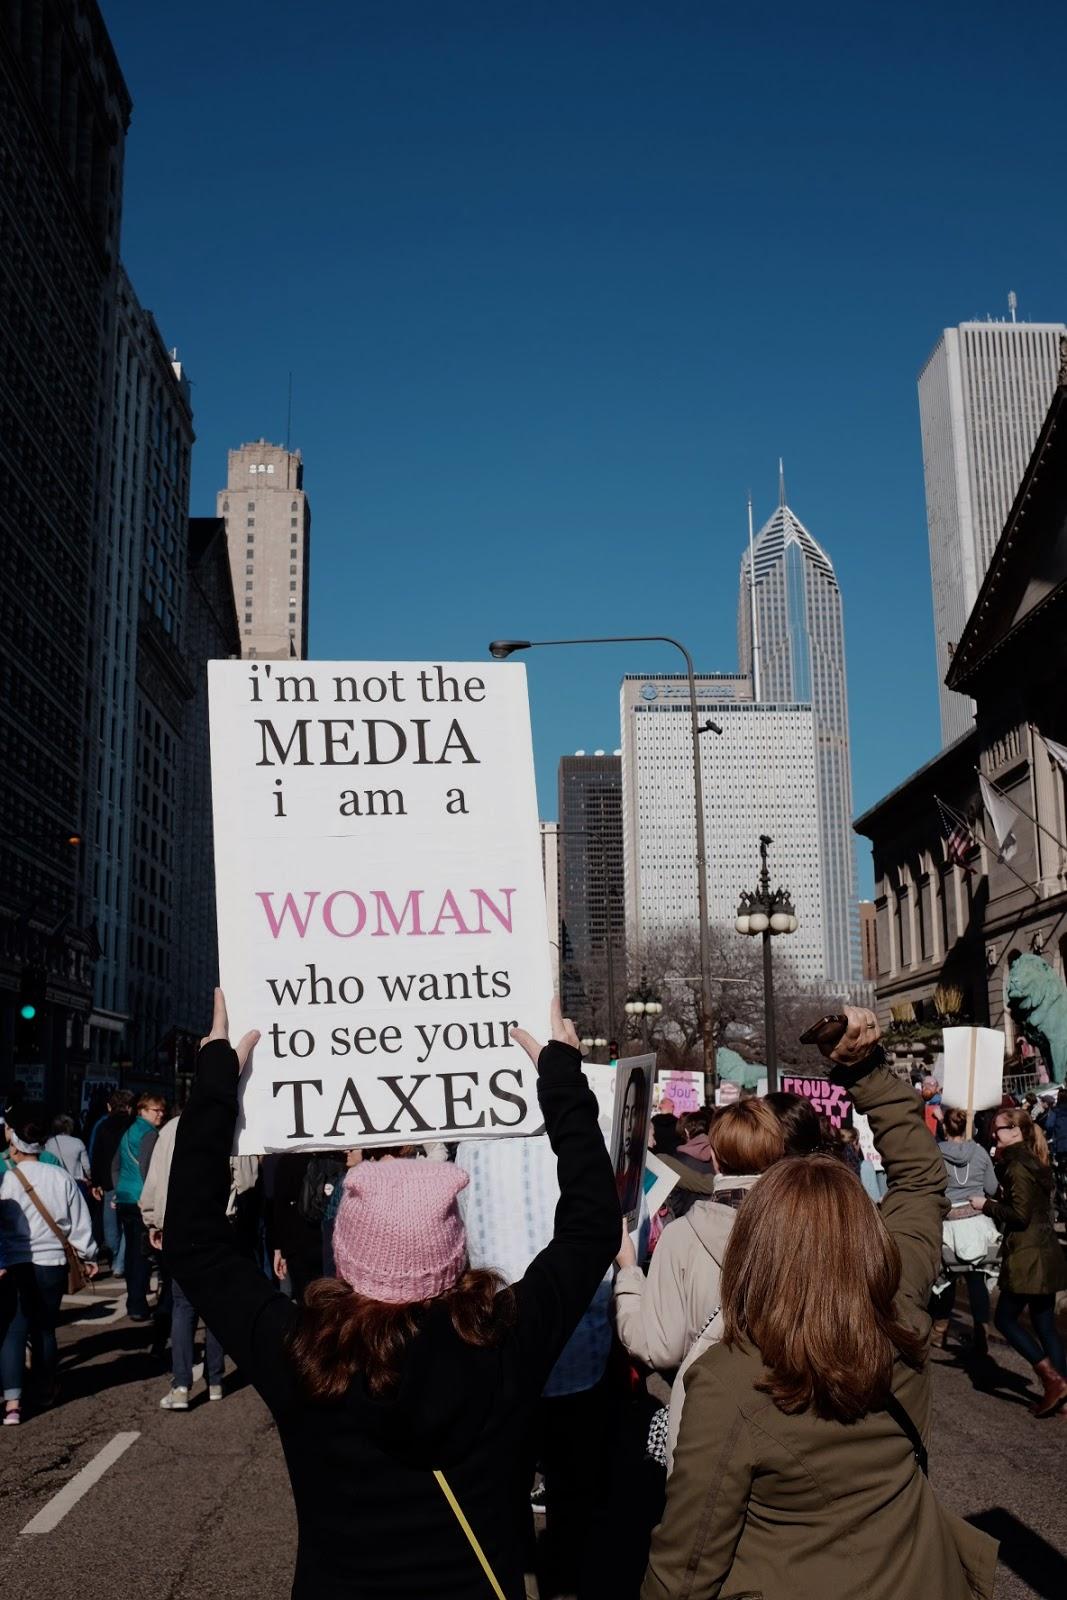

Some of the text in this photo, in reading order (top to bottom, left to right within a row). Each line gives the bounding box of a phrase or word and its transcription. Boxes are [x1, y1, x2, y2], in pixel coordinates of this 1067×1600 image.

[249, 664, 485, 703] i'm not the
[254, 718, 481, 767] MEDIA
[273, 778, 469, 818] i am a
[256, 888, 516, 939] WOMAN
[266, 963, 511, 1007] who wants
[268, 1019, 518, 1063] to see your
[272, 1068, 527, 1140] TAXES
[810, 1098, 851, 1118] STY
